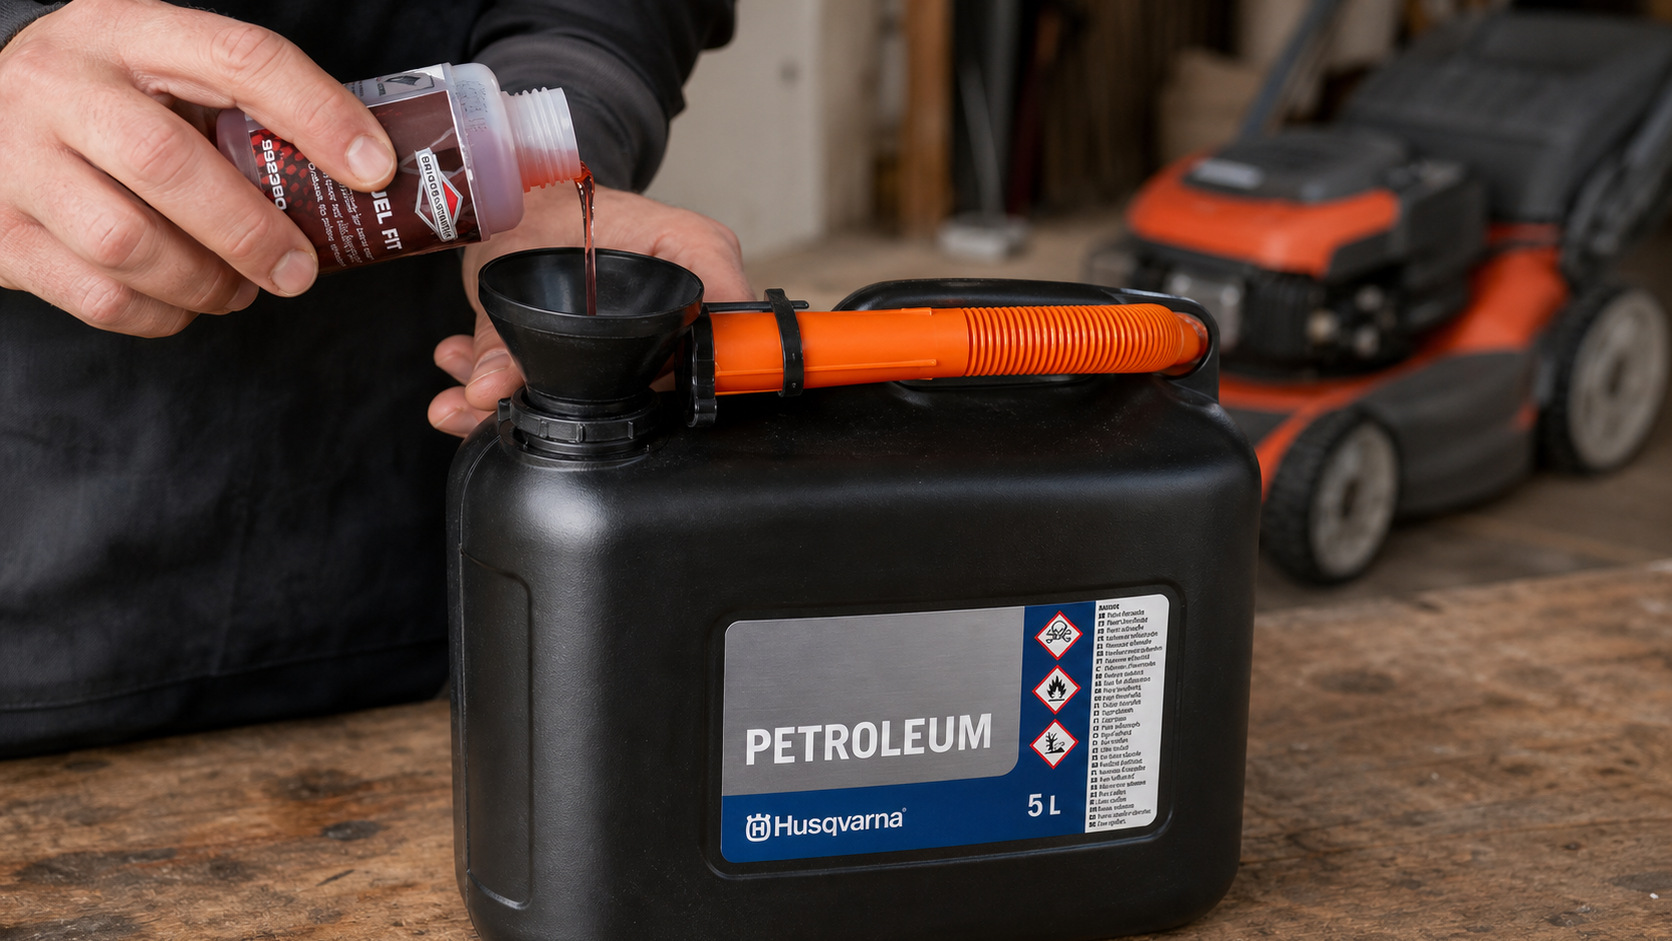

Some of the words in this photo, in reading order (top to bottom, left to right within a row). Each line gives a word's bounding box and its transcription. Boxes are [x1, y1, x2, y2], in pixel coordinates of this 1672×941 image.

[370, 191, 393, 225] UEL
[381, 228, 403, 250] FIT
[745, 712, 992, 766] PETROLEUM
[1027, 793, 1044, 817] 5
[1049, 795, 1061, 816] L
[774, 811, 904, 837] Husqvarna
